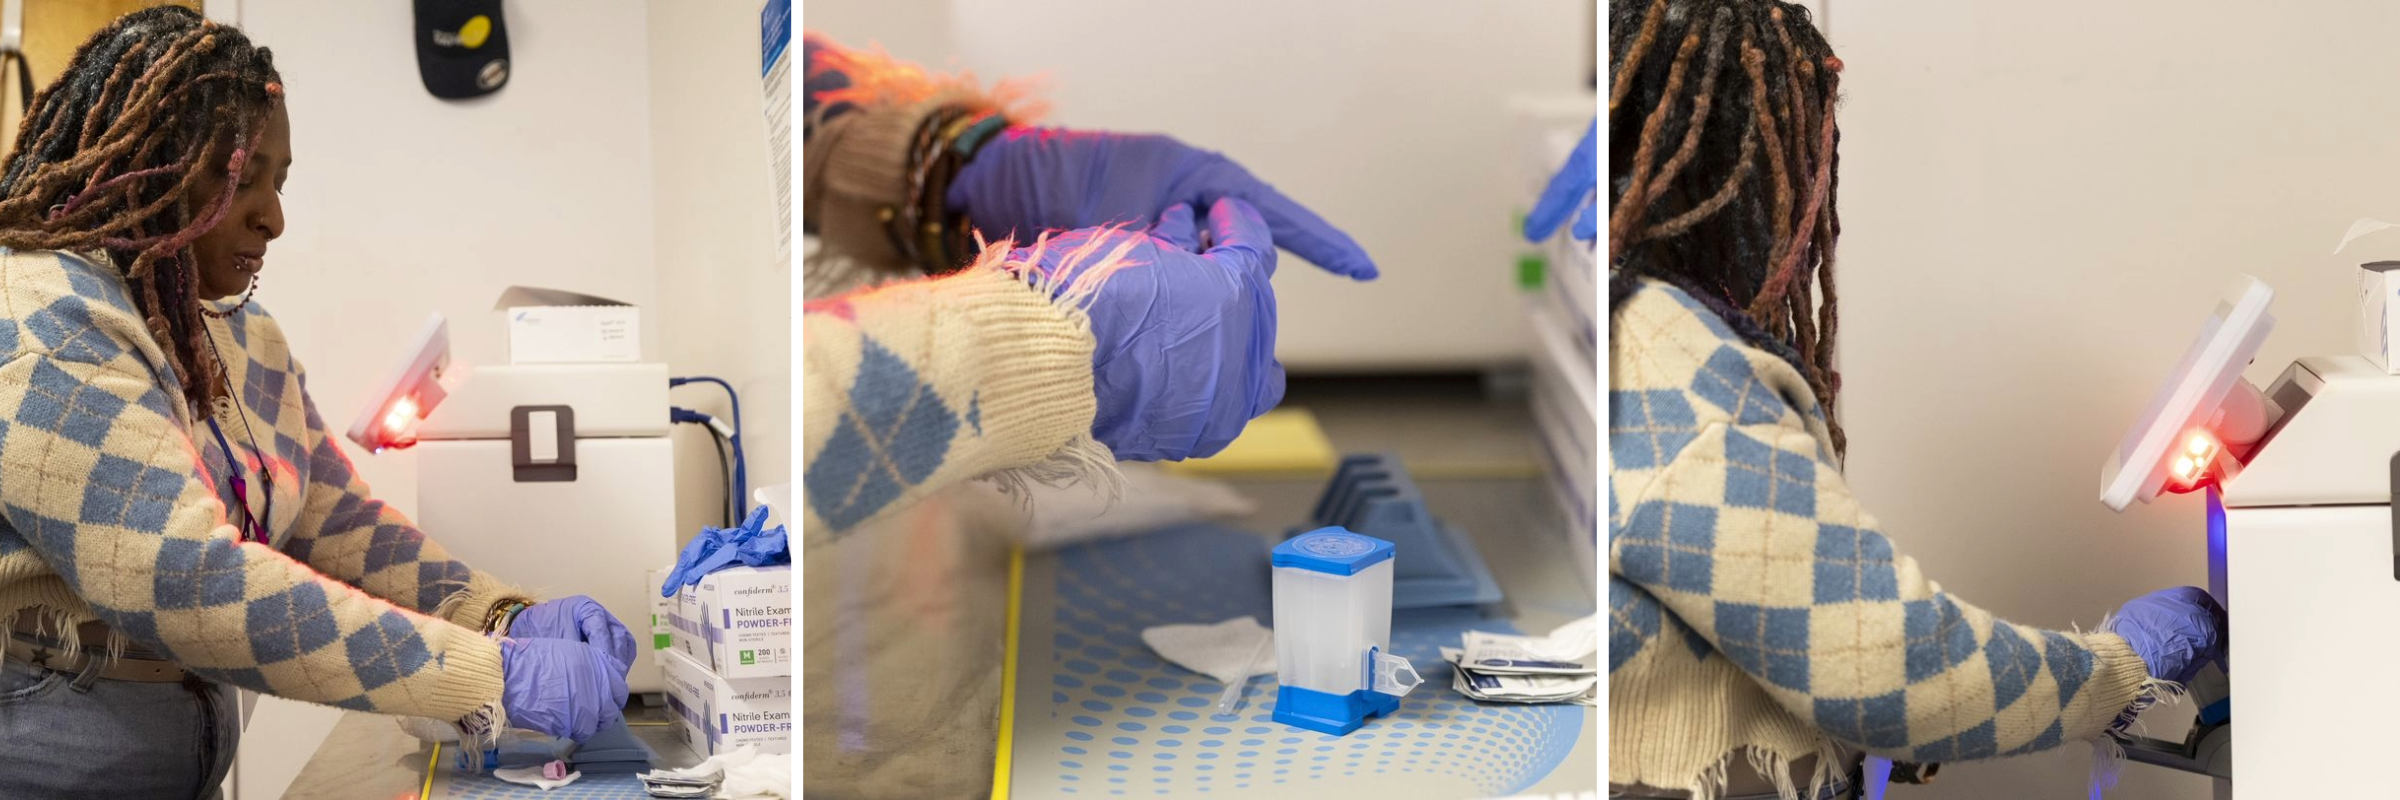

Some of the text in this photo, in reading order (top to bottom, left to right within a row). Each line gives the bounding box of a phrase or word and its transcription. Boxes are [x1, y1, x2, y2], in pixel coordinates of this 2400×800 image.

[736, 606, 792, 617] Nitrile Exam
[733, 711, 790, 721] Nitrile Exam
